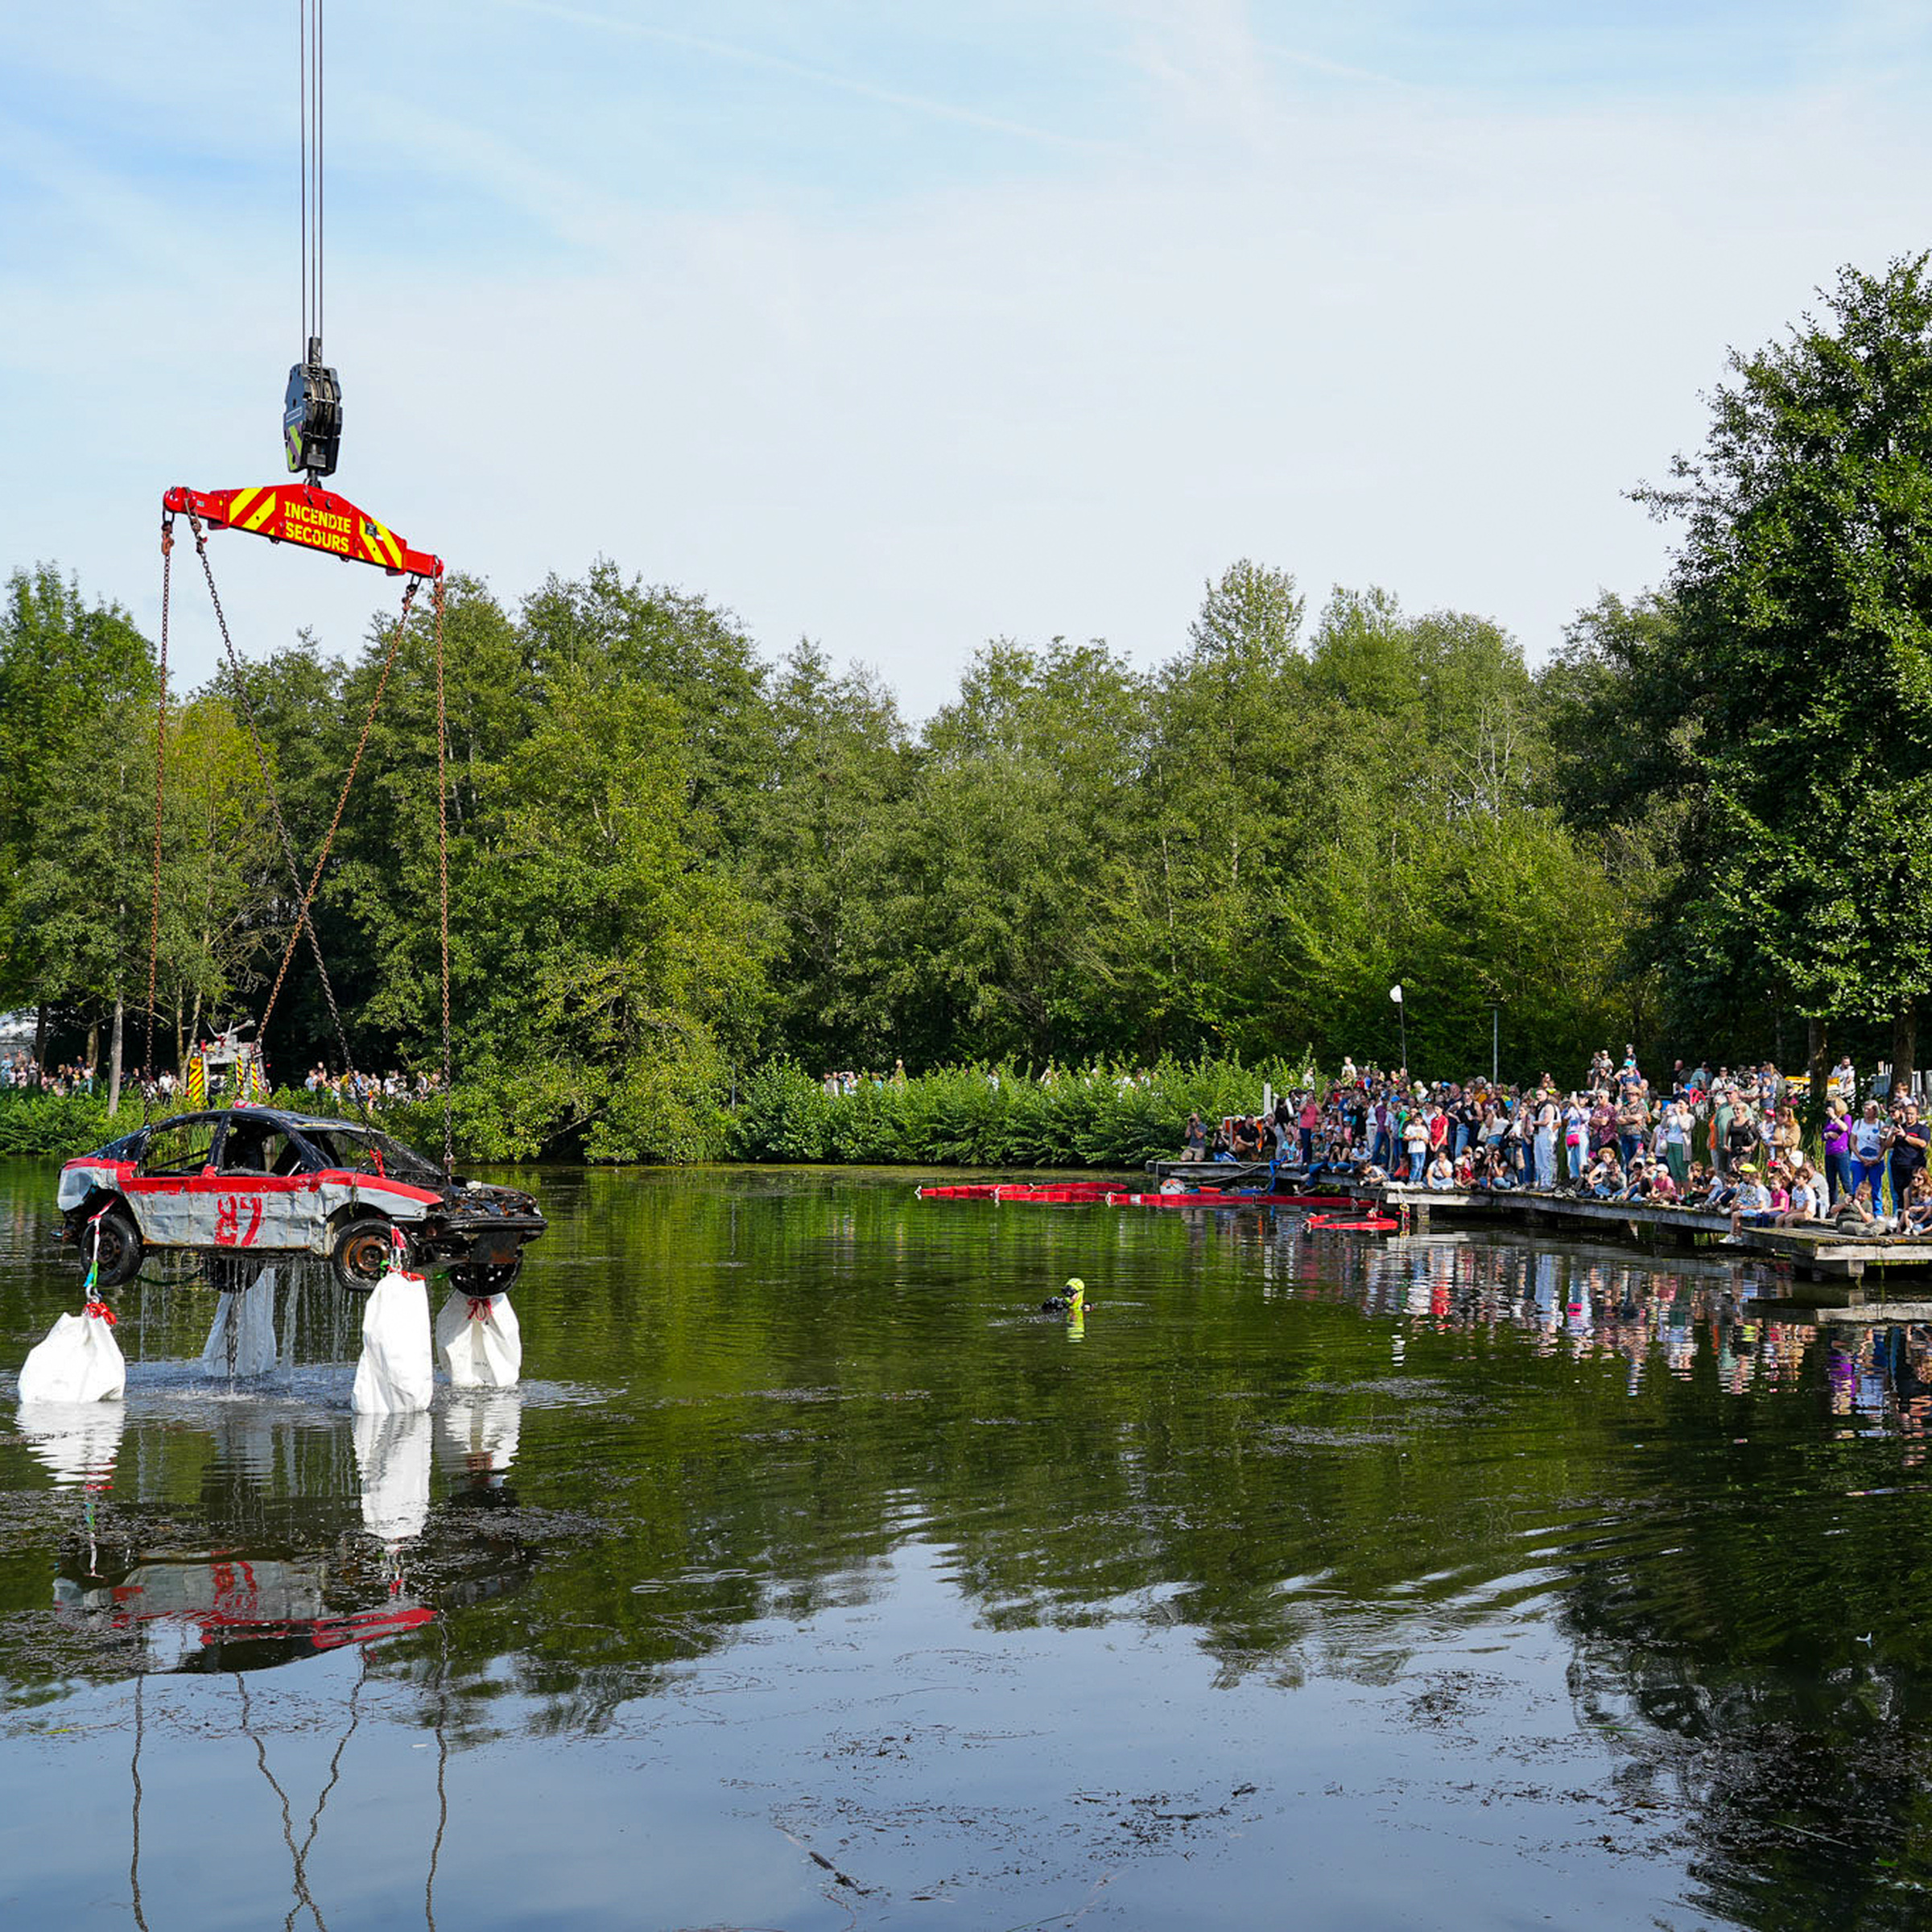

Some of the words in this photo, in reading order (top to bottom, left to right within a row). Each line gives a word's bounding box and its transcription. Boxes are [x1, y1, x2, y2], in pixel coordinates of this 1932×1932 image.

[284, 501, 351, 534] INCENDIE
[286, 522, 349, 552] SECOURS
[214, 1195, 262, 1246] 87
